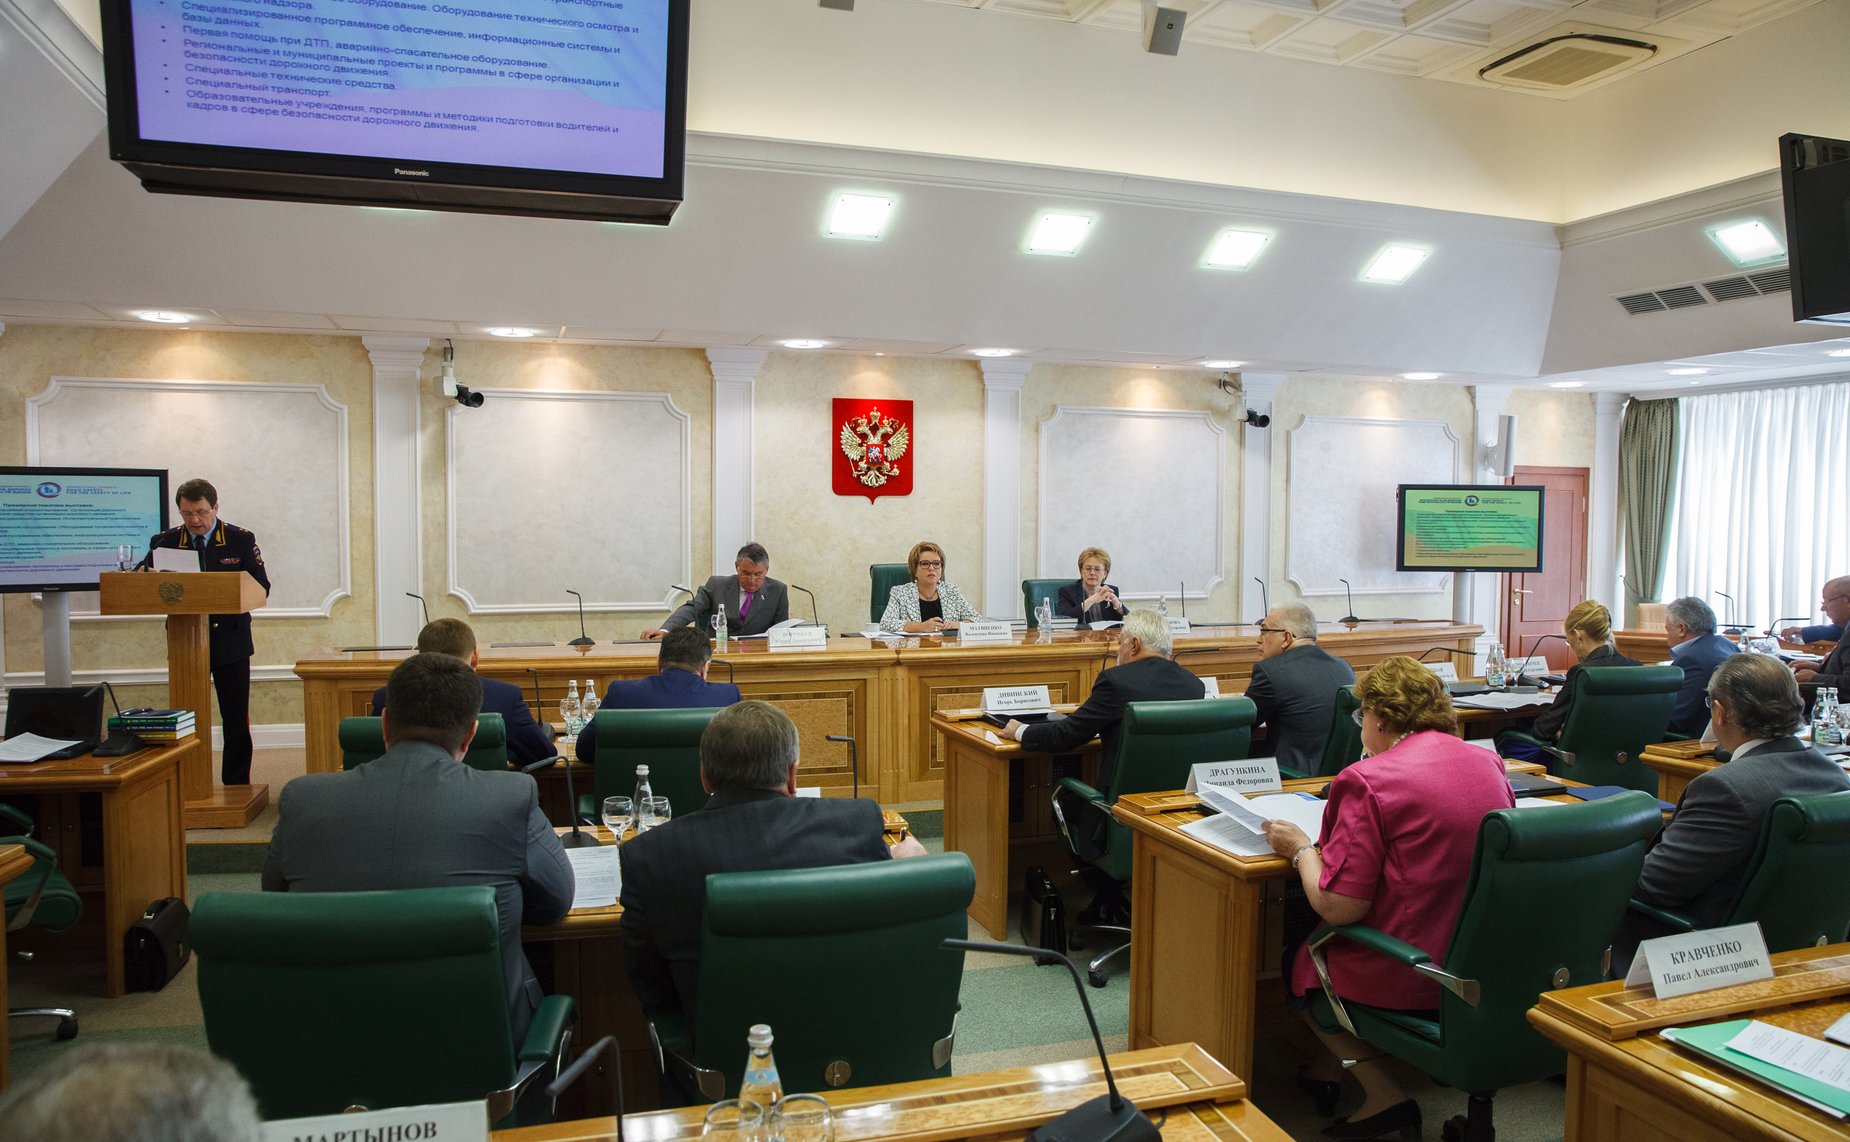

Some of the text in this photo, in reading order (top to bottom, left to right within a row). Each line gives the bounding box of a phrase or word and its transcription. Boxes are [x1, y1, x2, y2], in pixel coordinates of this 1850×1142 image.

[181, 1, 312, 23] Специализированное
[314, 17, 390, 31] программное
[392, 24, 466, 39] обеспечение,
[468, 33, 565, 48] информационные
[567, 42, 613, 53] системы
[182, 12, 264, 29] базы данных.
[432, 4, 513, 20] Оборудование
[515, 13, 584, 28] технического
[586, 22, 630, 33] осмотра
[183, 25, 229, 38] Первая
[231, 32, 278, 44] помощь
[280, 36, 301, 46] при
[335, 42, 470, 61] аварийно-спасательное
[472, 55, 550, 69] оборудование.
[184, 39, 271, 55] Региональные
[282, 51, 375, 66] муниципальные
[378, 58, 424, 70] проекты
[436, 65, 497, 77] программы
[508, 70, 543, 82] сфере
[545, 75, 611, 88] организации
[184, 51, 391, 78] безопасности дорожного движения.
[185, 63, 398, 91] Специальные технические средства.
[185, 76, 331, 98] Специальный транспорт.
[186, 89, 294, 107] Образовательные
[369, 106, 432, 119] программы
[443, 113, 494, 124] методики
[495, 117, 554, 128] подготовки
[556, 122, 611, 133] водителей
[186, 101, 229, 112] кадров
[240, 106, 279, 117] сфере
[281, 109, 360, 122] безопасности
[362, 115, 422, 128] дорожного
[423, 121, 480, 133] движения.
[394, 168, 429, 177] Panasonic
[998, 689, 1038, 698] ДИВИНСКИЙ
[1209, 766, 1266, 777] ДРАГУНКИНА
[1236, 777, 1274, 786] Федоровна
[1670, 940, 1742, 965] КРАВЧЕНКО
[1663, 958, 1760, 985] Павел Александрович
